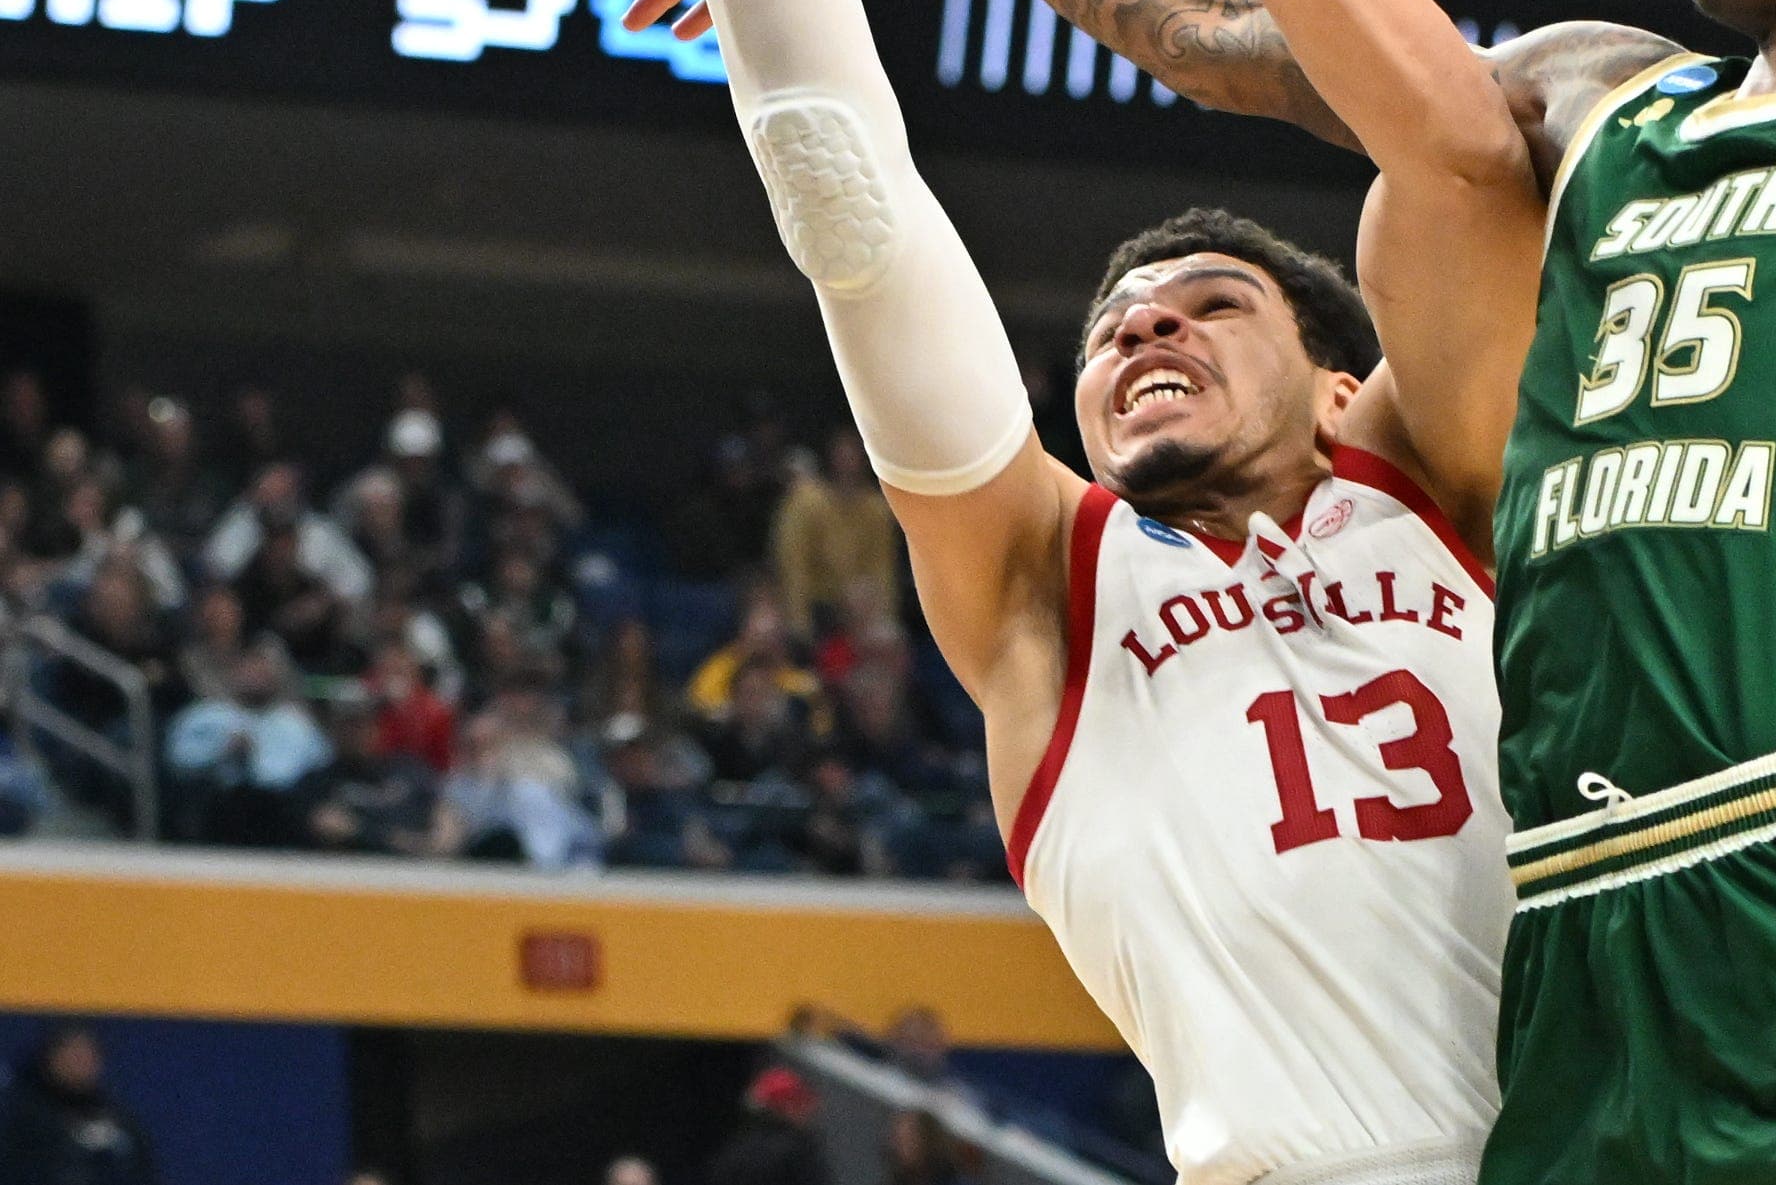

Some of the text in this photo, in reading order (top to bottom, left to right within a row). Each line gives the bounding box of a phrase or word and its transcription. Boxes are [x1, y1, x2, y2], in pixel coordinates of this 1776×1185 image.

[1573, 257, 1757, 427] 35
[1531, 439, 1776, 560] FLORIDA
[1245, 668, 1474, 855] 13
